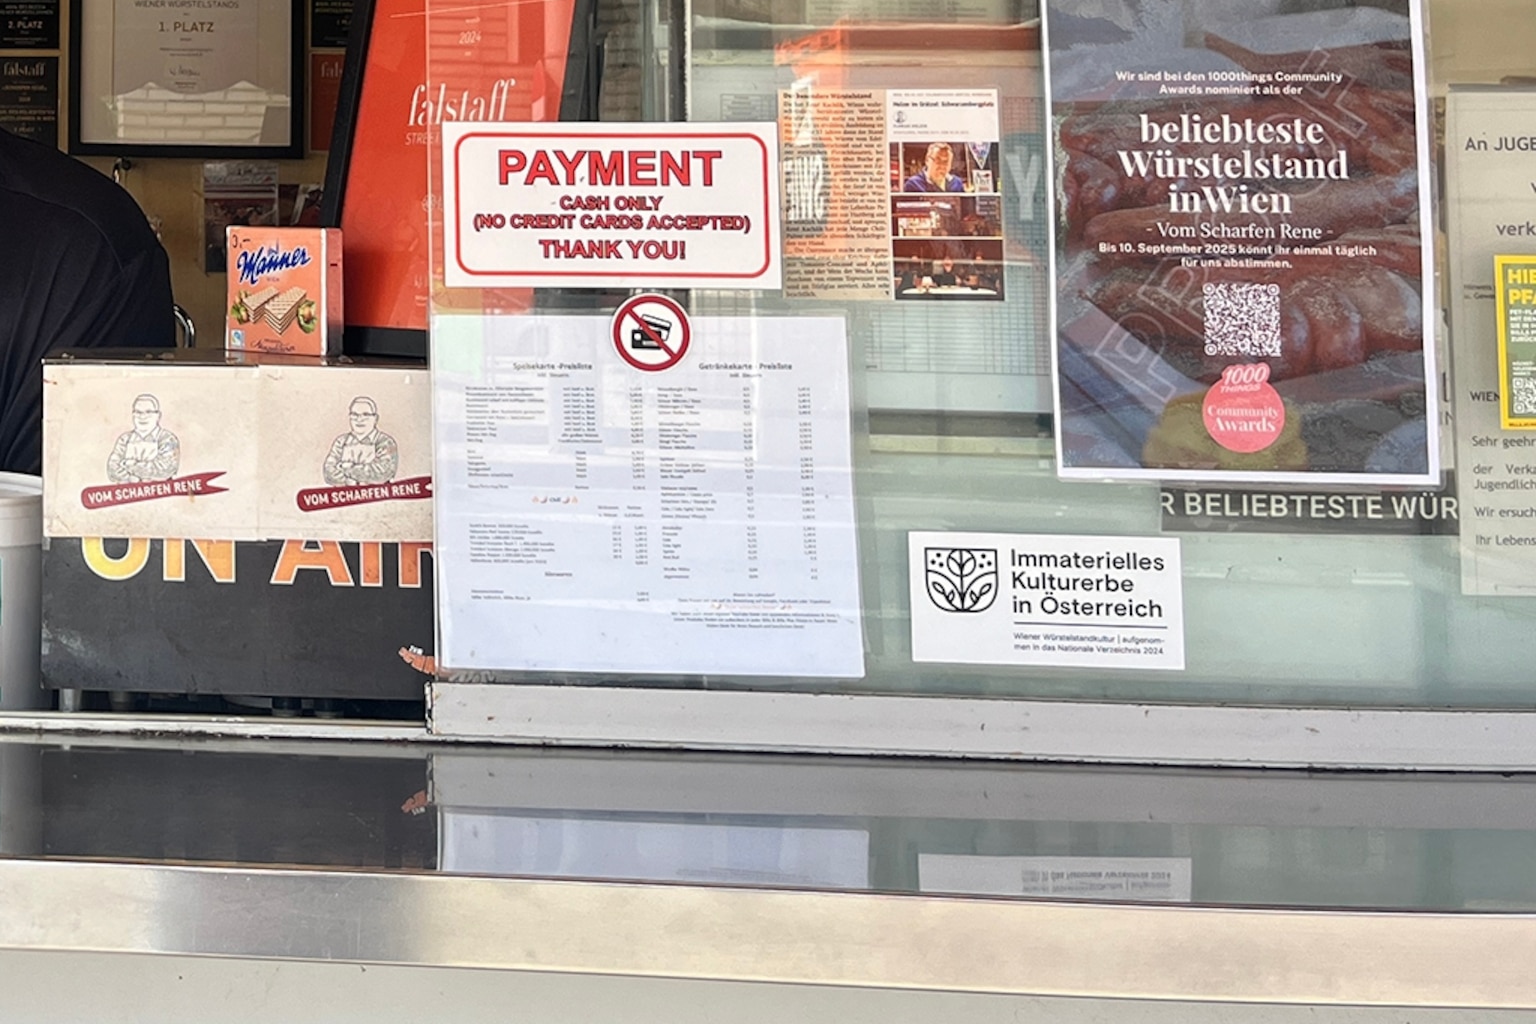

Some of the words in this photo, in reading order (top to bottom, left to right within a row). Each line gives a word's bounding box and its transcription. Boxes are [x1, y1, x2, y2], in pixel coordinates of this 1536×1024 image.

[134, 1, 166, 9] WIENER
[17, 20, 44, 29] PLATZ
[158, 21, 170, 33] 1.
[174, 21, 214, 33] PLATZ
[459, 31, 482, 45] 2024
[3, 61, 46, 76] falstaff
[1115, 71, 1136, 82] Wir
[1138, 71, 1162, 82] sind
[1164, 71, 1182, 82] bei
[1184, 71, 1206, 82] den
[1208, 71, 1273, 84] 1000things
[1275, 71, 1343, 84] Community
[1159, 84, 1203, 95] Awards
[1205, 84, 1260, 95] nominiert
[1263, 84, 1281, 95] als
[1282, 84, 1303, 95] der
[408, 78, 516, 126] falstaff
[1139, 113, 1324, 144] beliebteste
[1465, 137, 1488, 151] An
[498, 150, 722, 187] PAYMENT
[1117, 149, 1350, 180] Würstelstand
[559, 195, 610, 211] CASH
[614, 195, 664, 211] ONLY
[473, 214, 505, 231] (NO
[510, 214, 576, 230] CREDIT
[580, 214, 643, 230] CARDS
[647, 215, 752, 233] ACCEPTED)
[1156, 223, 1195, 239] Vom
[1199, 222, 1276, 240] Scharfen
[1280, 224, 1323, 240] Rene
[538, 239, 623, 259] THANK
[626, 240, 687, 260] YOU!
[1099, 243, 1116, 253] Bis
[1119, 243, 1136, 253] 10.
[1138, 243, 1203, 255] September
[1205, 243, 1237, 254] 2025
[1238, 243, 1273, 255] könnt
[1274, 244, 1291, 255] ihr
[1293, 245, 1332, 256] einmal
[1335, 245, 1377, 258] täglich
[237, 247, 312, 284] Manner
[1181, 257, 1198, 268] für
[1200, 258, 1222, 268] uns
[1223, 257, 1293, 269] abstimmen.
[699, 362, 752, 371] Getränkekarte
[1224, 366, 1267, 385] 1000
[1220, 384, 1262, 393] THINGS
[1207, 404, 1278, 420] Community
[1215, 416, 1276, 432] Awards
[1472, 436, 1498, 447] Sehr
[1473, 464, 1493, 474] der
[88, 490, 112, 504] VOM
[115, 483, 171, 502] SCHARFEN
[174, 479, 203, 493] RENE
[303, 493, 329, 506] VOM
[332, 486, 390, 504] SCHARFEN
[392, 482, 421, 497] RENE
[1184, 492, 1383, 518] BELIEBTESTE
[1391, 491, 1459, 520] WÜR
[1474, 507, 1494, 517] Wir
[1476, 535, 1491, 545] Ihr
[1011, 548, 1165, 571] Immaterielles
[1012, 571, 1135, 592] Kulturerbe
[1013, 595, 1032, 613] in
[1040, 591, 1163, 618] Österreich
[1014, 632, 1041, 640] Wiener
[1043, 632, 1116, 643] Würstelstandkultur
[1122, 636, 1165, 645] aufgenom-
[1041, 643, 1056, 651] das
[1057, 644, 1094, 653] Nationale
[1096, 645, 1141, 654] Verzeichnis
[1143, 647, 1164, 655] 2024
